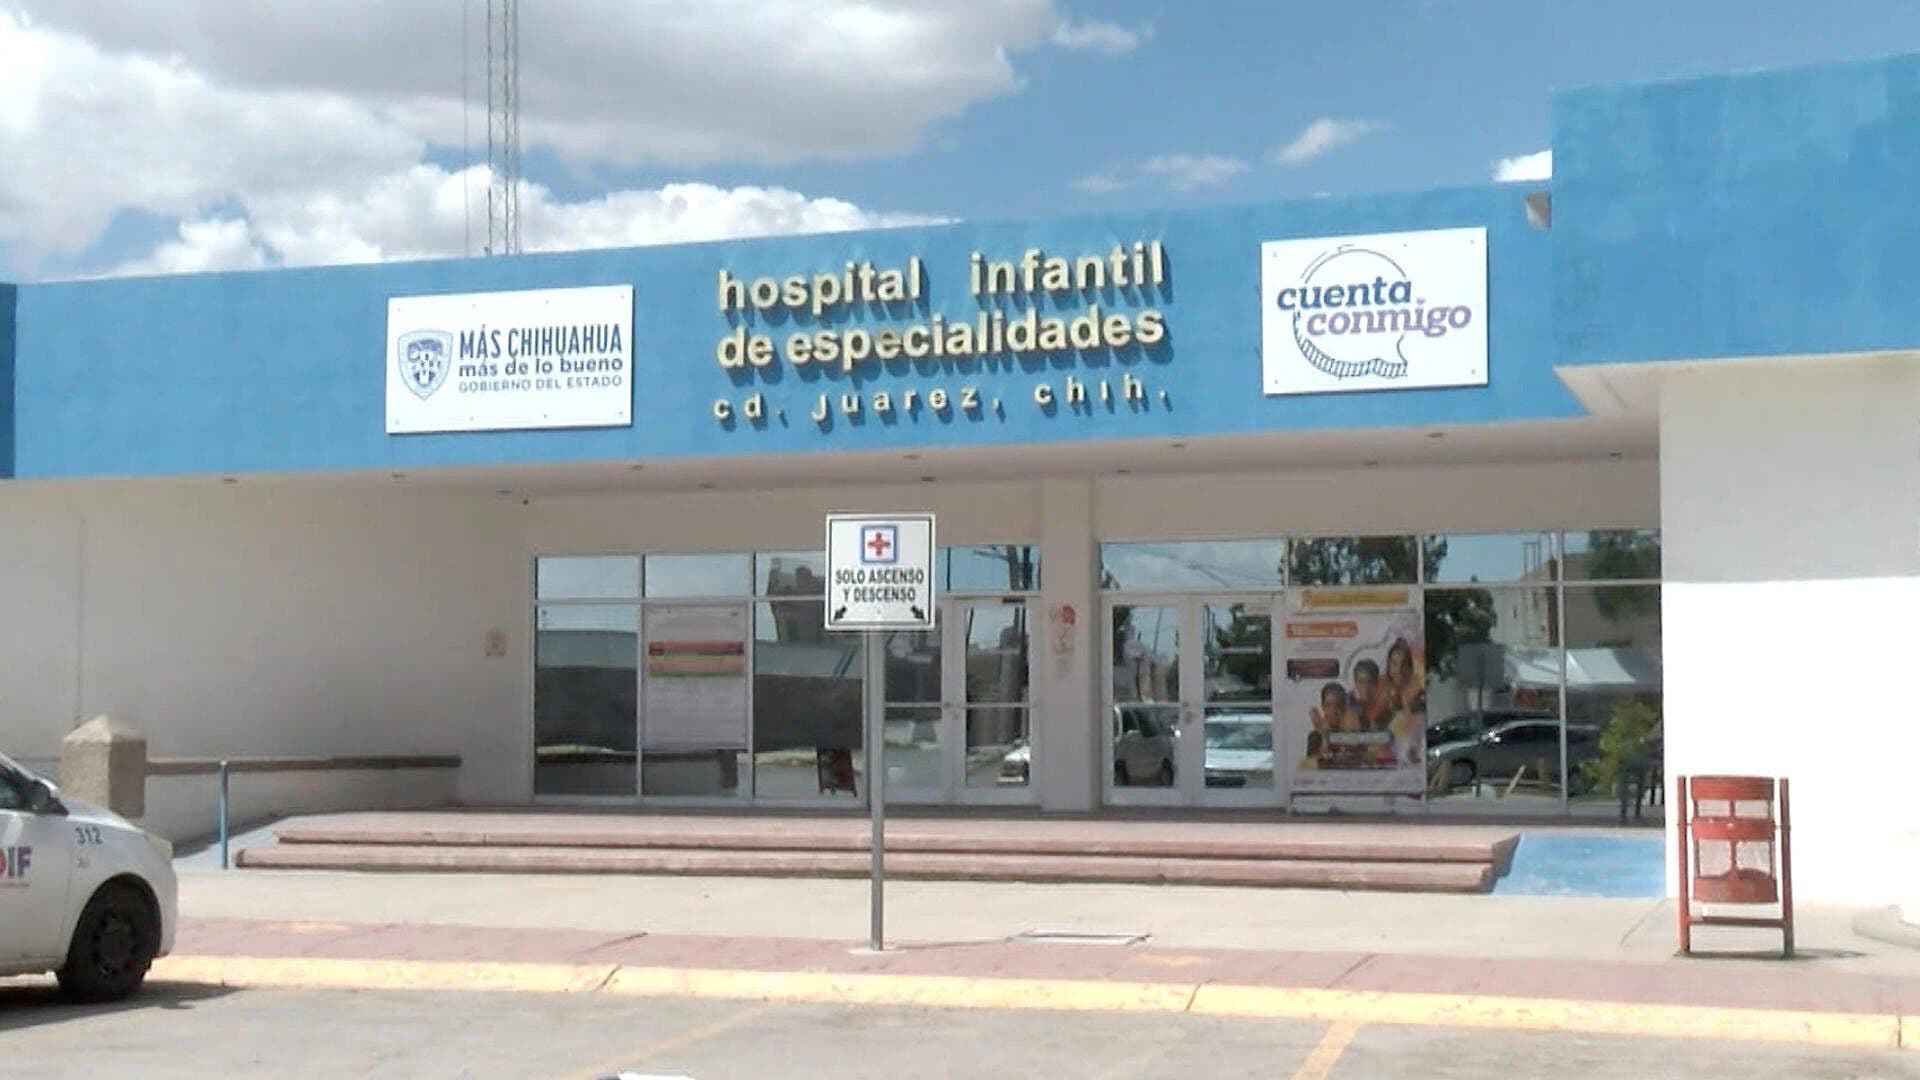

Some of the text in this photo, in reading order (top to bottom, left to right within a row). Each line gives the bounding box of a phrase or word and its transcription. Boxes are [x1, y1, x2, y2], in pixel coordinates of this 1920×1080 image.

[718, 239, 1165, 315] hospital infantil
[1277, 276, 1412, 310] cuenta
[1306, 298, 1472, 338] conmigo
[460, 323, 622, 359] MÁS CHIHUAHUA
[717, 303, 1165, 371] de especialidades
[459, 357, 623, 377] más de lo bueno
[459, 374, 622, 393] GOBIERNO DEL ESTADO
[835, 568, 924, 584] SOLO ASCENSO
[843, 586, 916, 602] Y DESCENSO
[75, 826, 104, 845] 312
